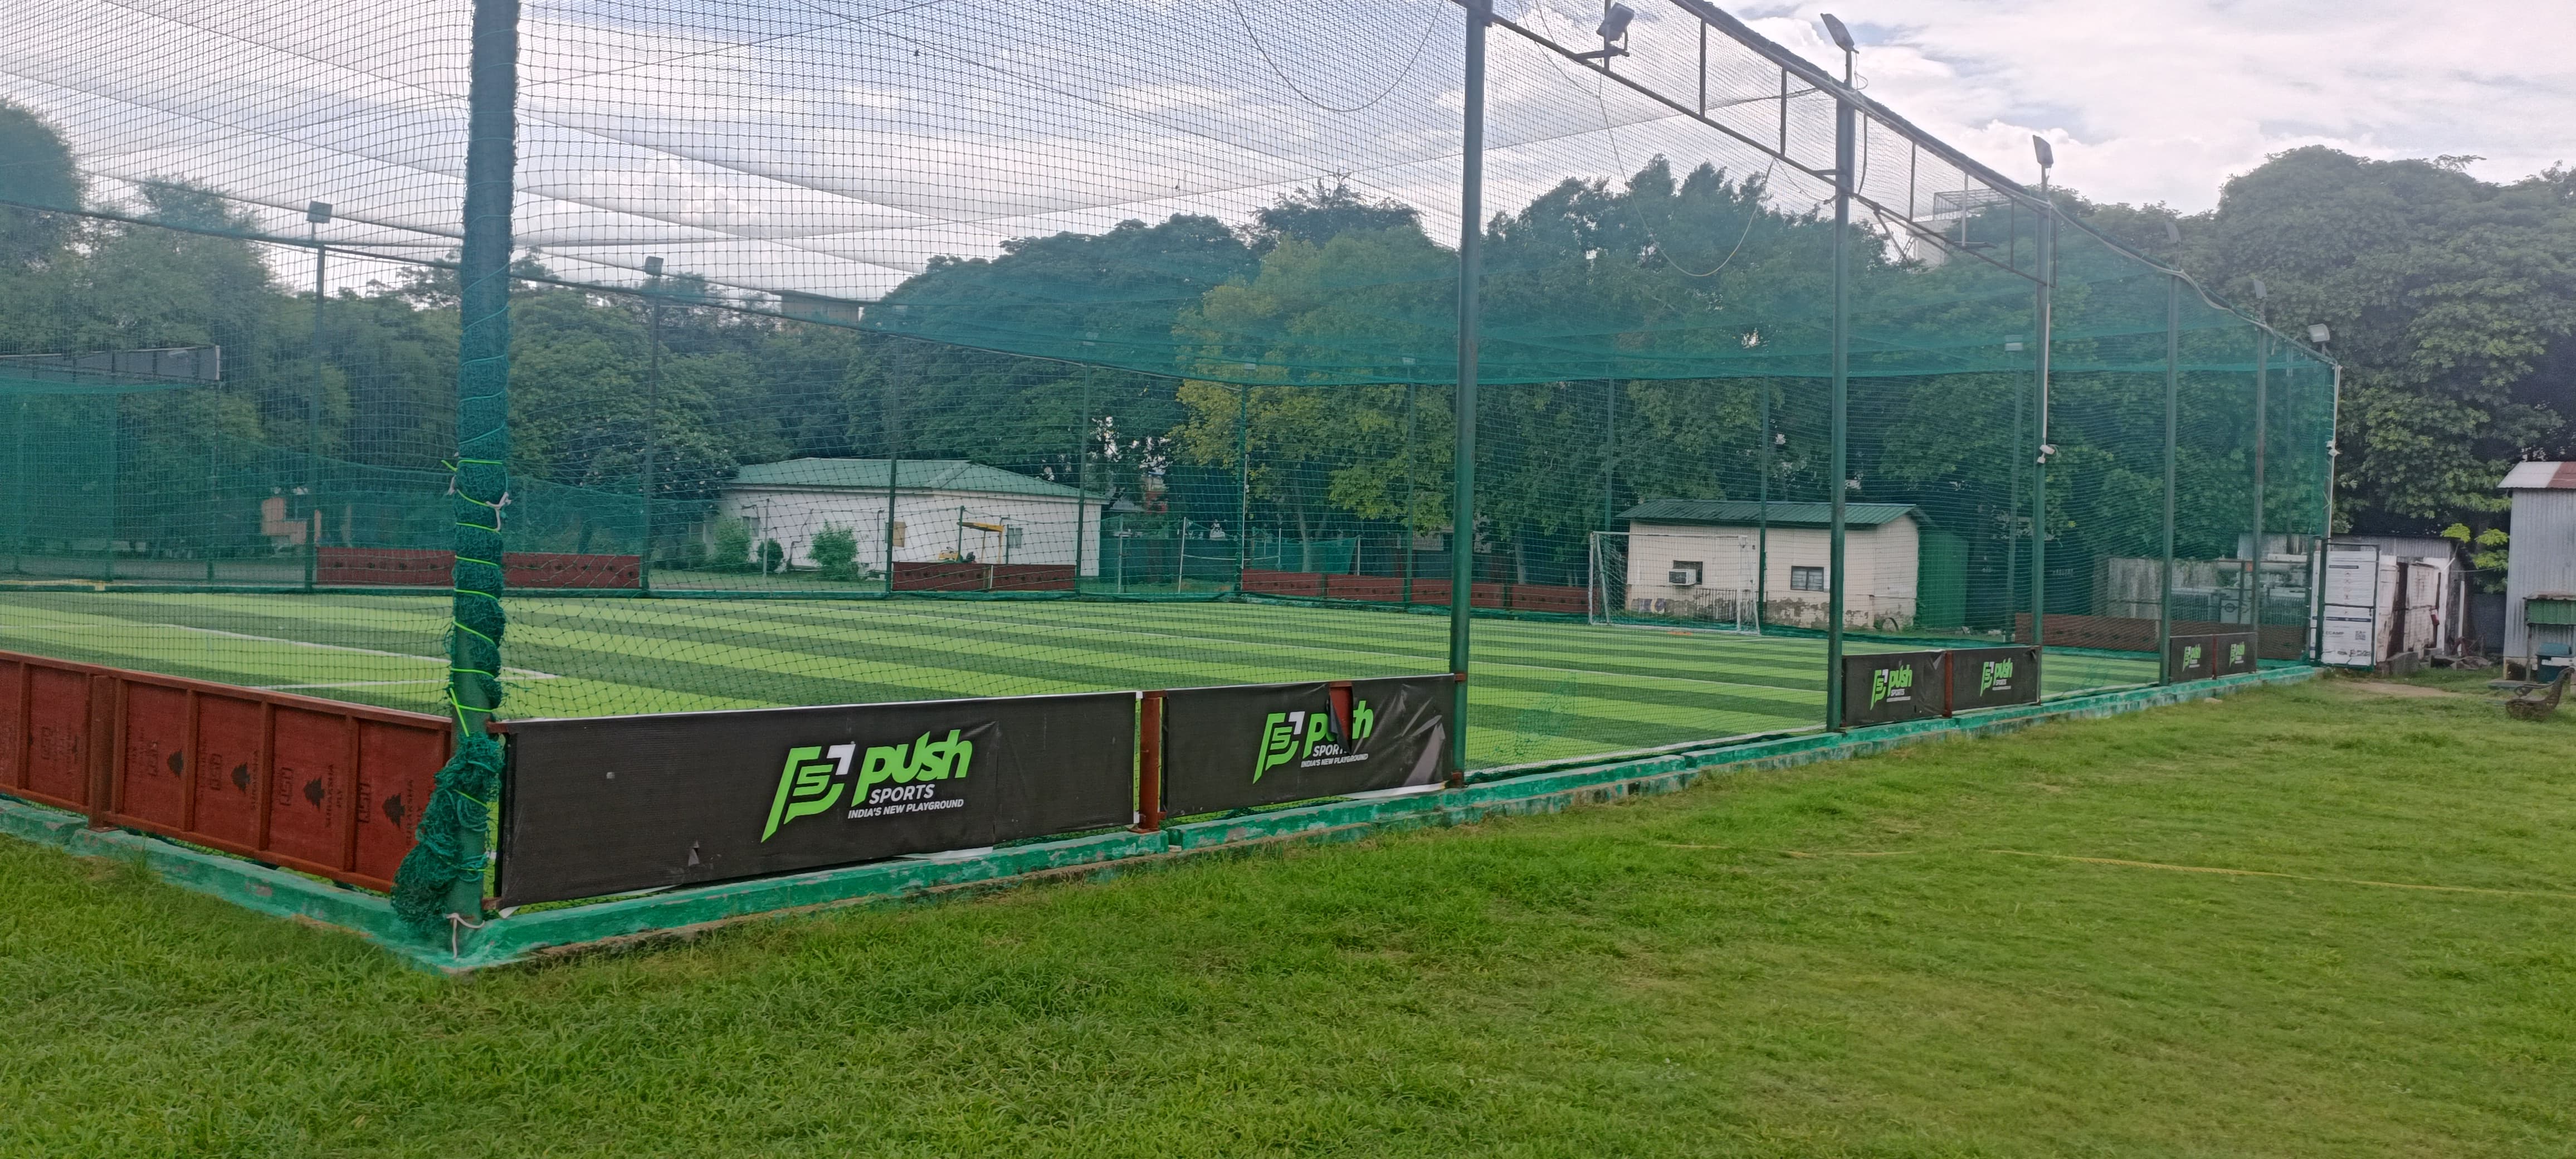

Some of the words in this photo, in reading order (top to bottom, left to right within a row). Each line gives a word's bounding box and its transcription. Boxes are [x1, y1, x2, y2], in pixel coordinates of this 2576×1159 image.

[869, 783, 936, 805] SPORTS
[847, 807, 882, 819] INDIA'S
[882, 803, 905, 816] NEW
[906, 798, 964, 813] PLAYGROUND
